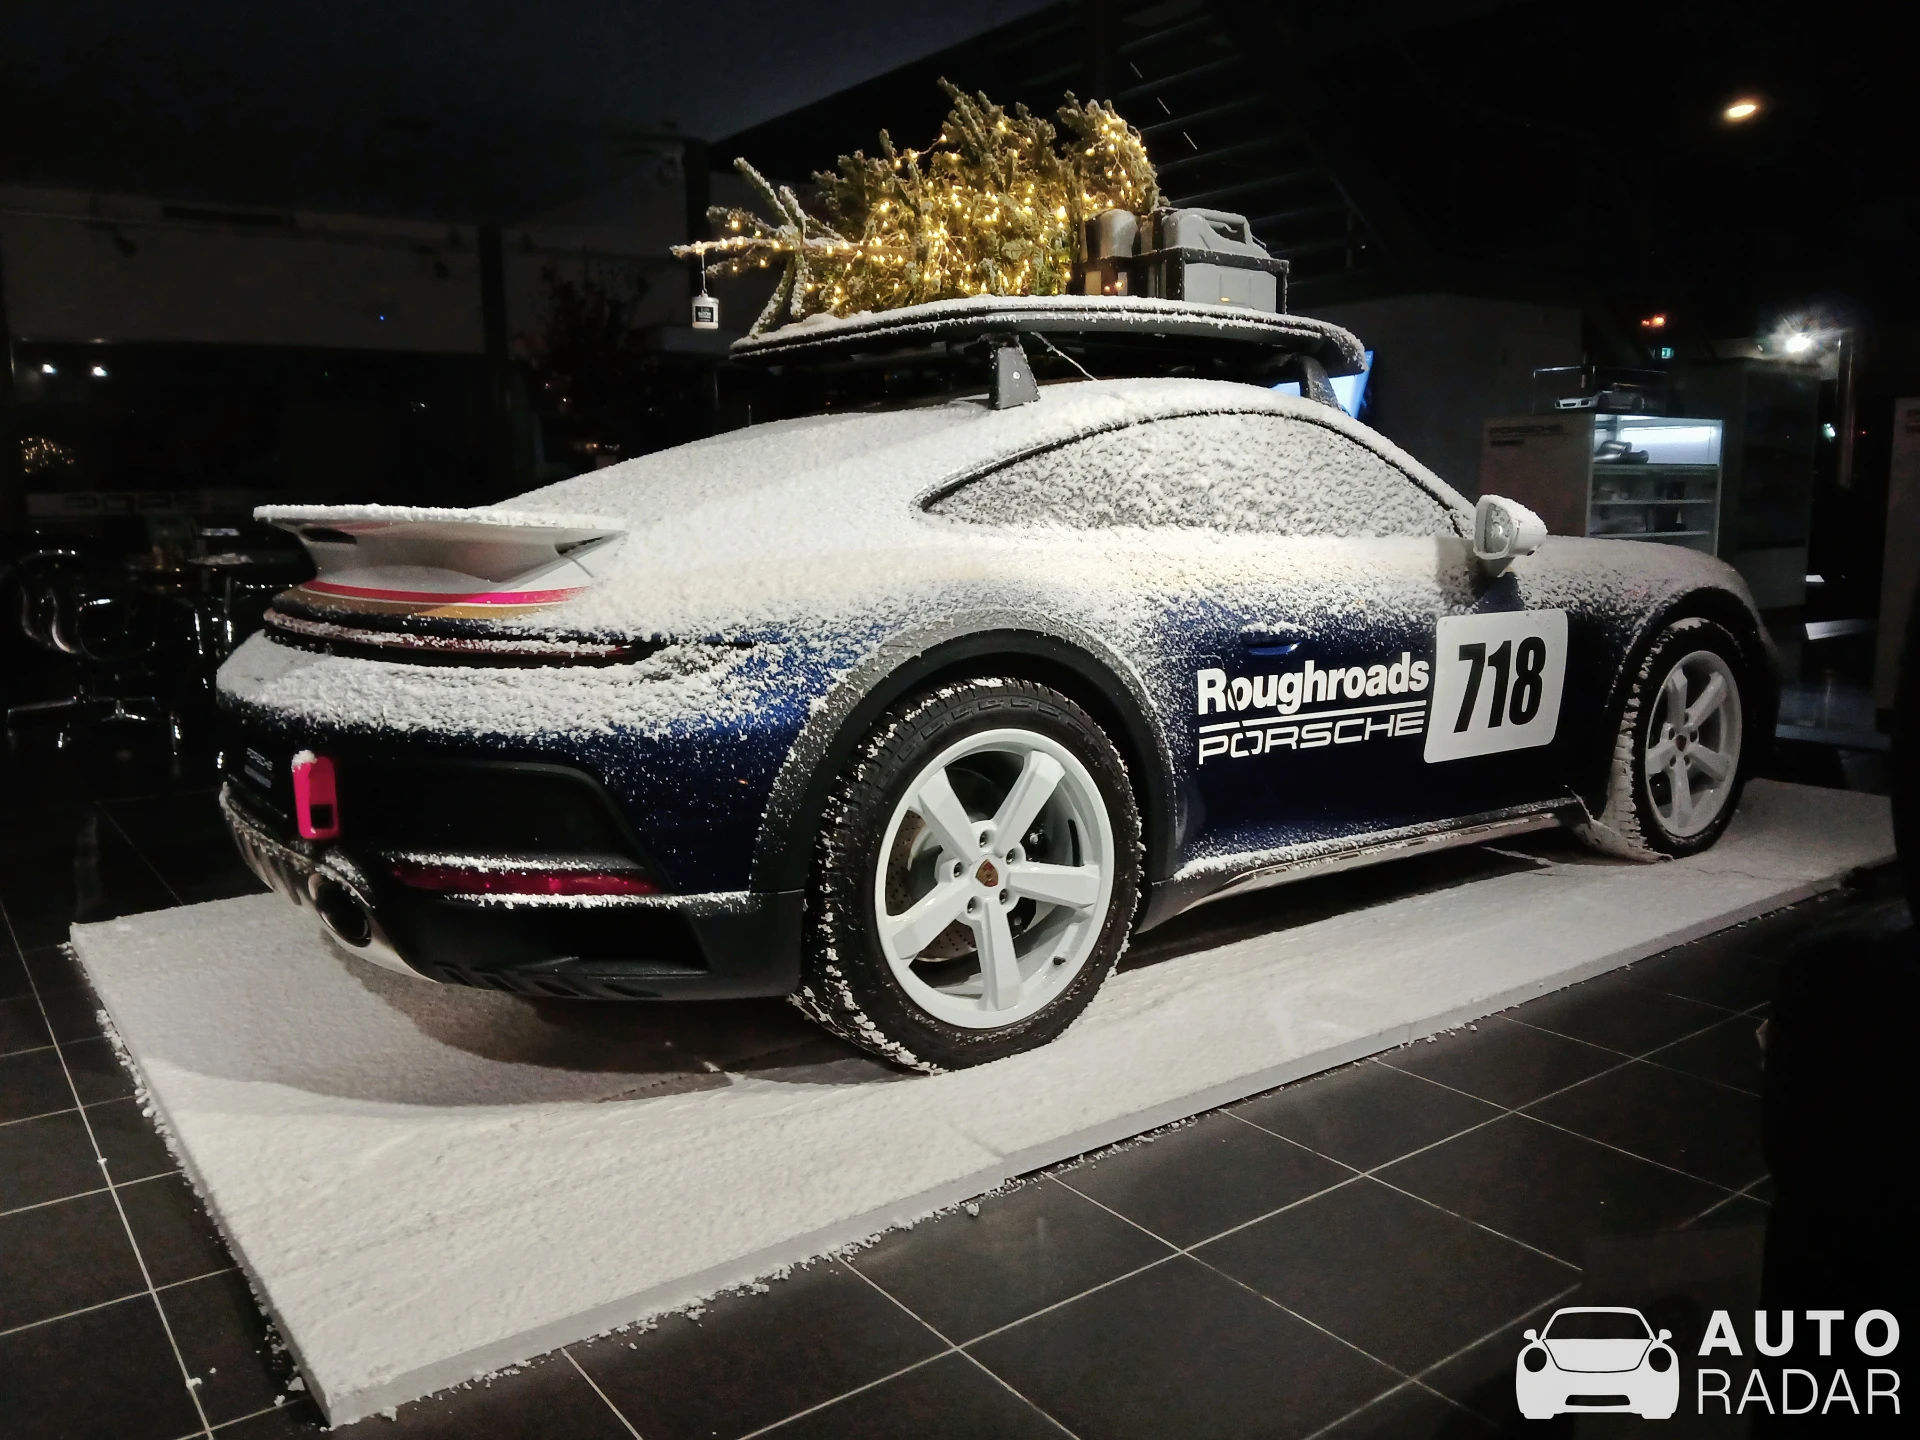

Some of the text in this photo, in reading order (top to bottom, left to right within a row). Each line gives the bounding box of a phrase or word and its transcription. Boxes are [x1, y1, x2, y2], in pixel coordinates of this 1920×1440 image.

[1196, 651, 1430, 716] Roughroads
[1454, 636, 1547, 734] 718
[1198, 710, 1426, 765] PORSCHE
